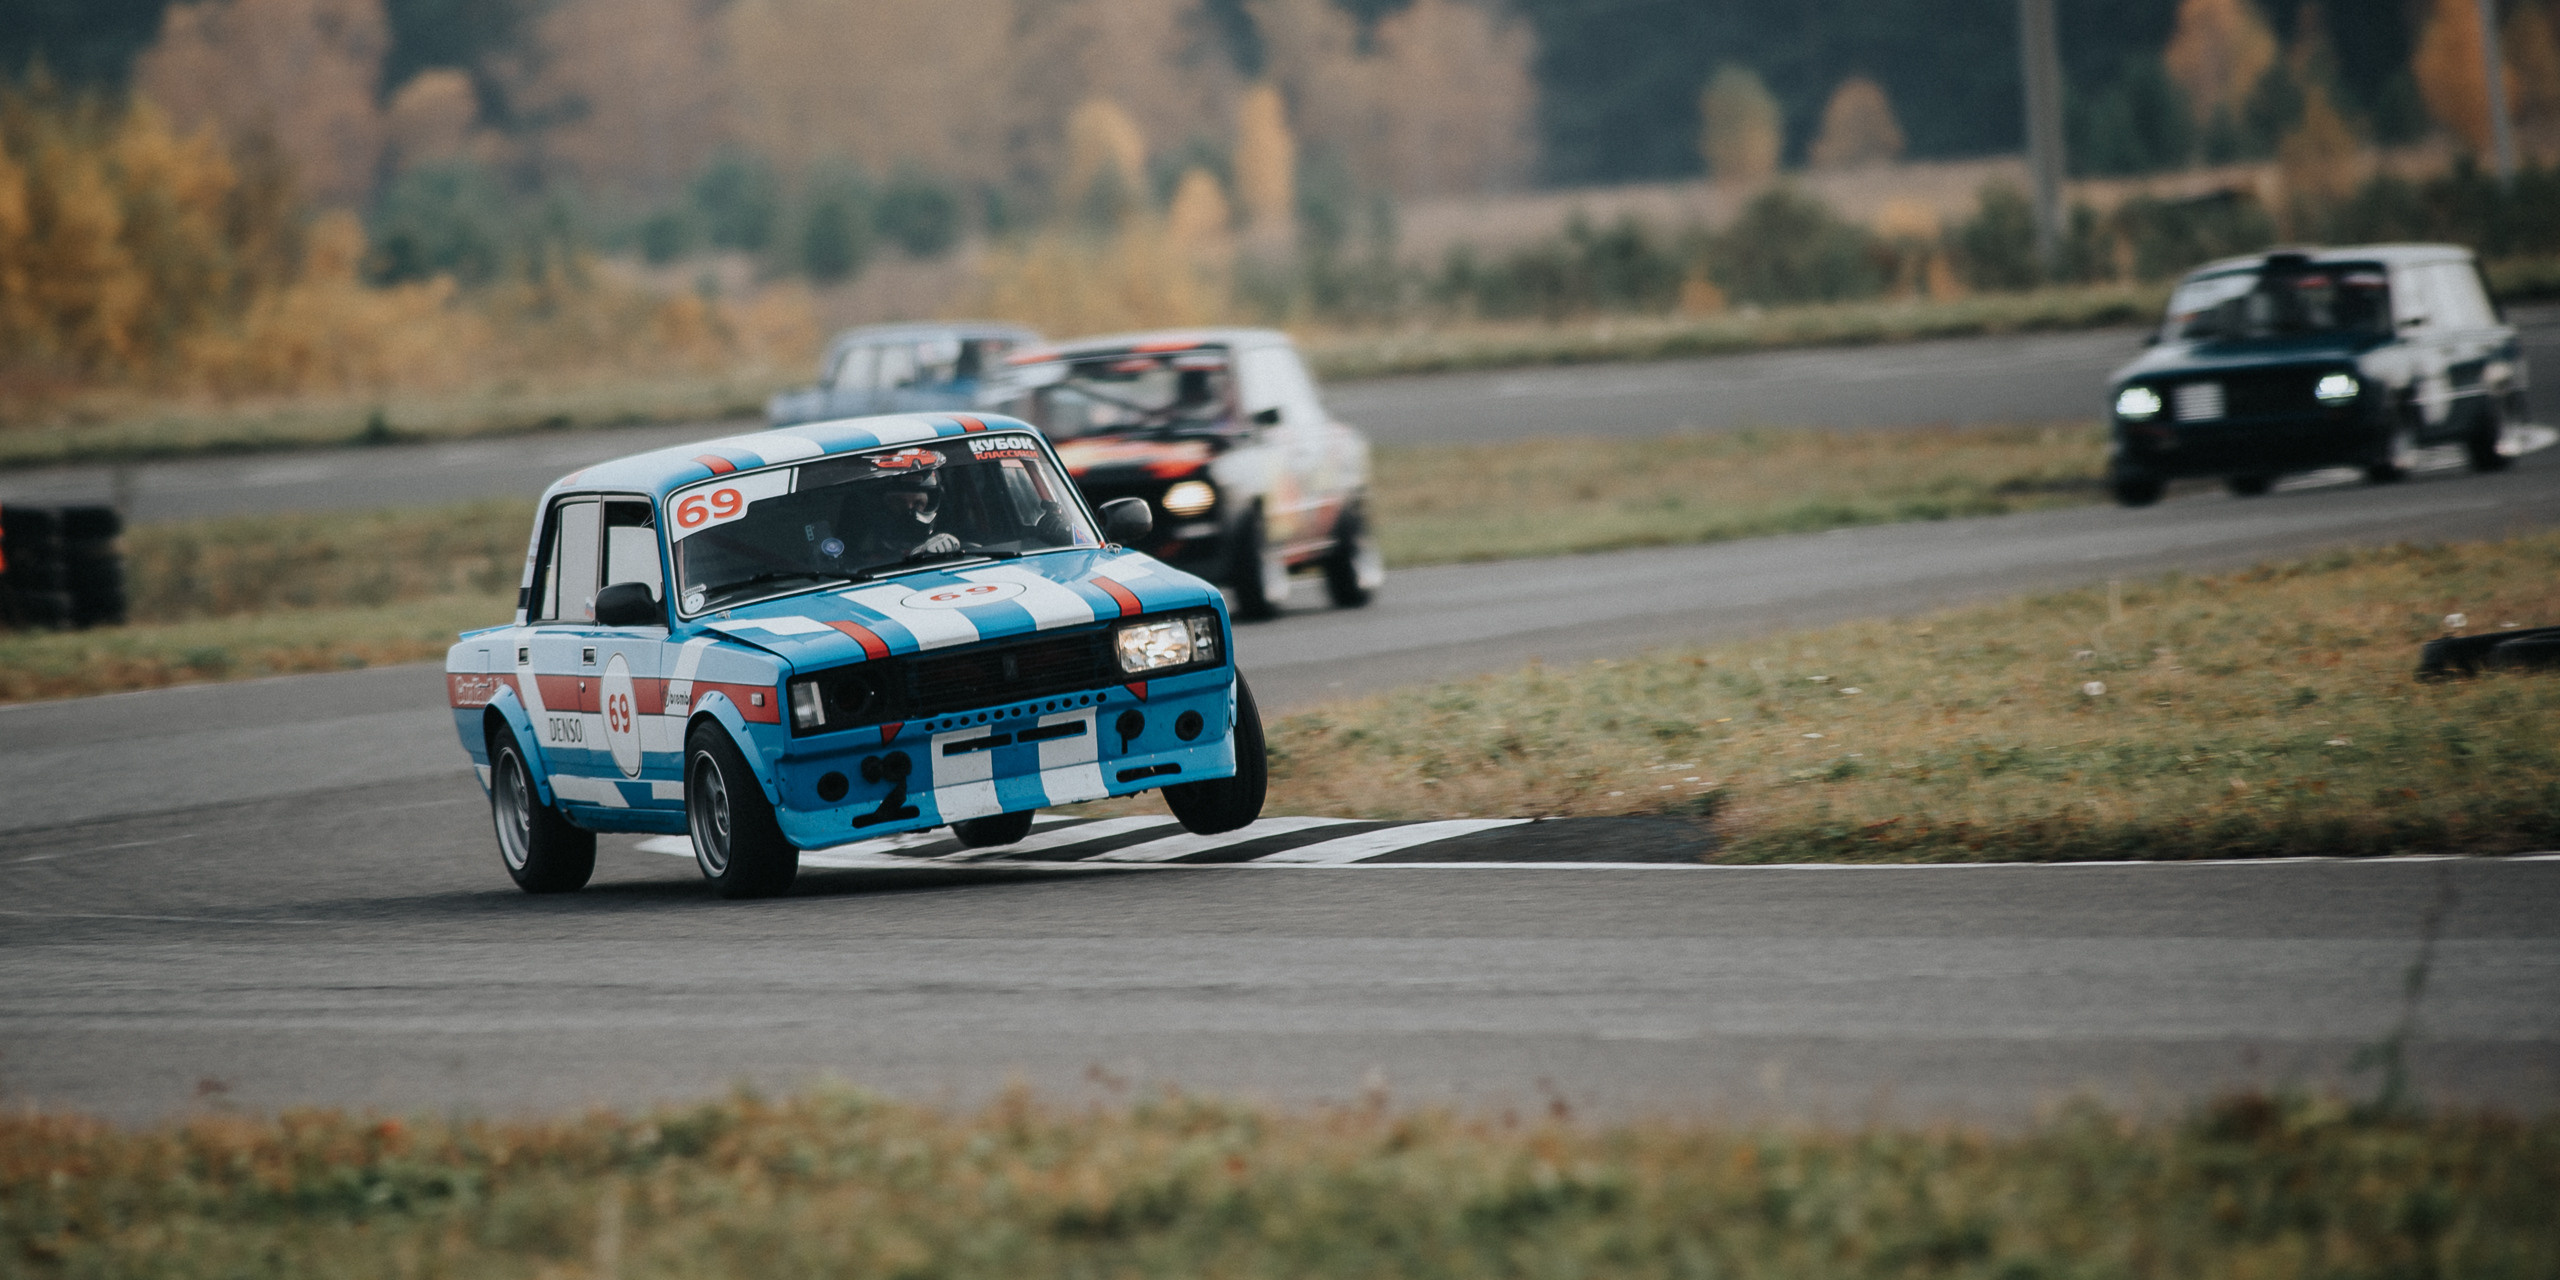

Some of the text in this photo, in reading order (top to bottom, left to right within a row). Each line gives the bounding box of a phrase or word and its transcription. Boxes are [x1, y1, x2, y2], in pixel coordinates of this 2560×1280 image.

[968, 437, 1035, 453] КУБОК
[973, 450, 1039, 460] КЛАССИКИ
[676, 488, 743, 529] 69
[929, 585, 998, 602] 69
[608, 692, 631, 734] 69
[549, 717, 583, 743] DENSO
